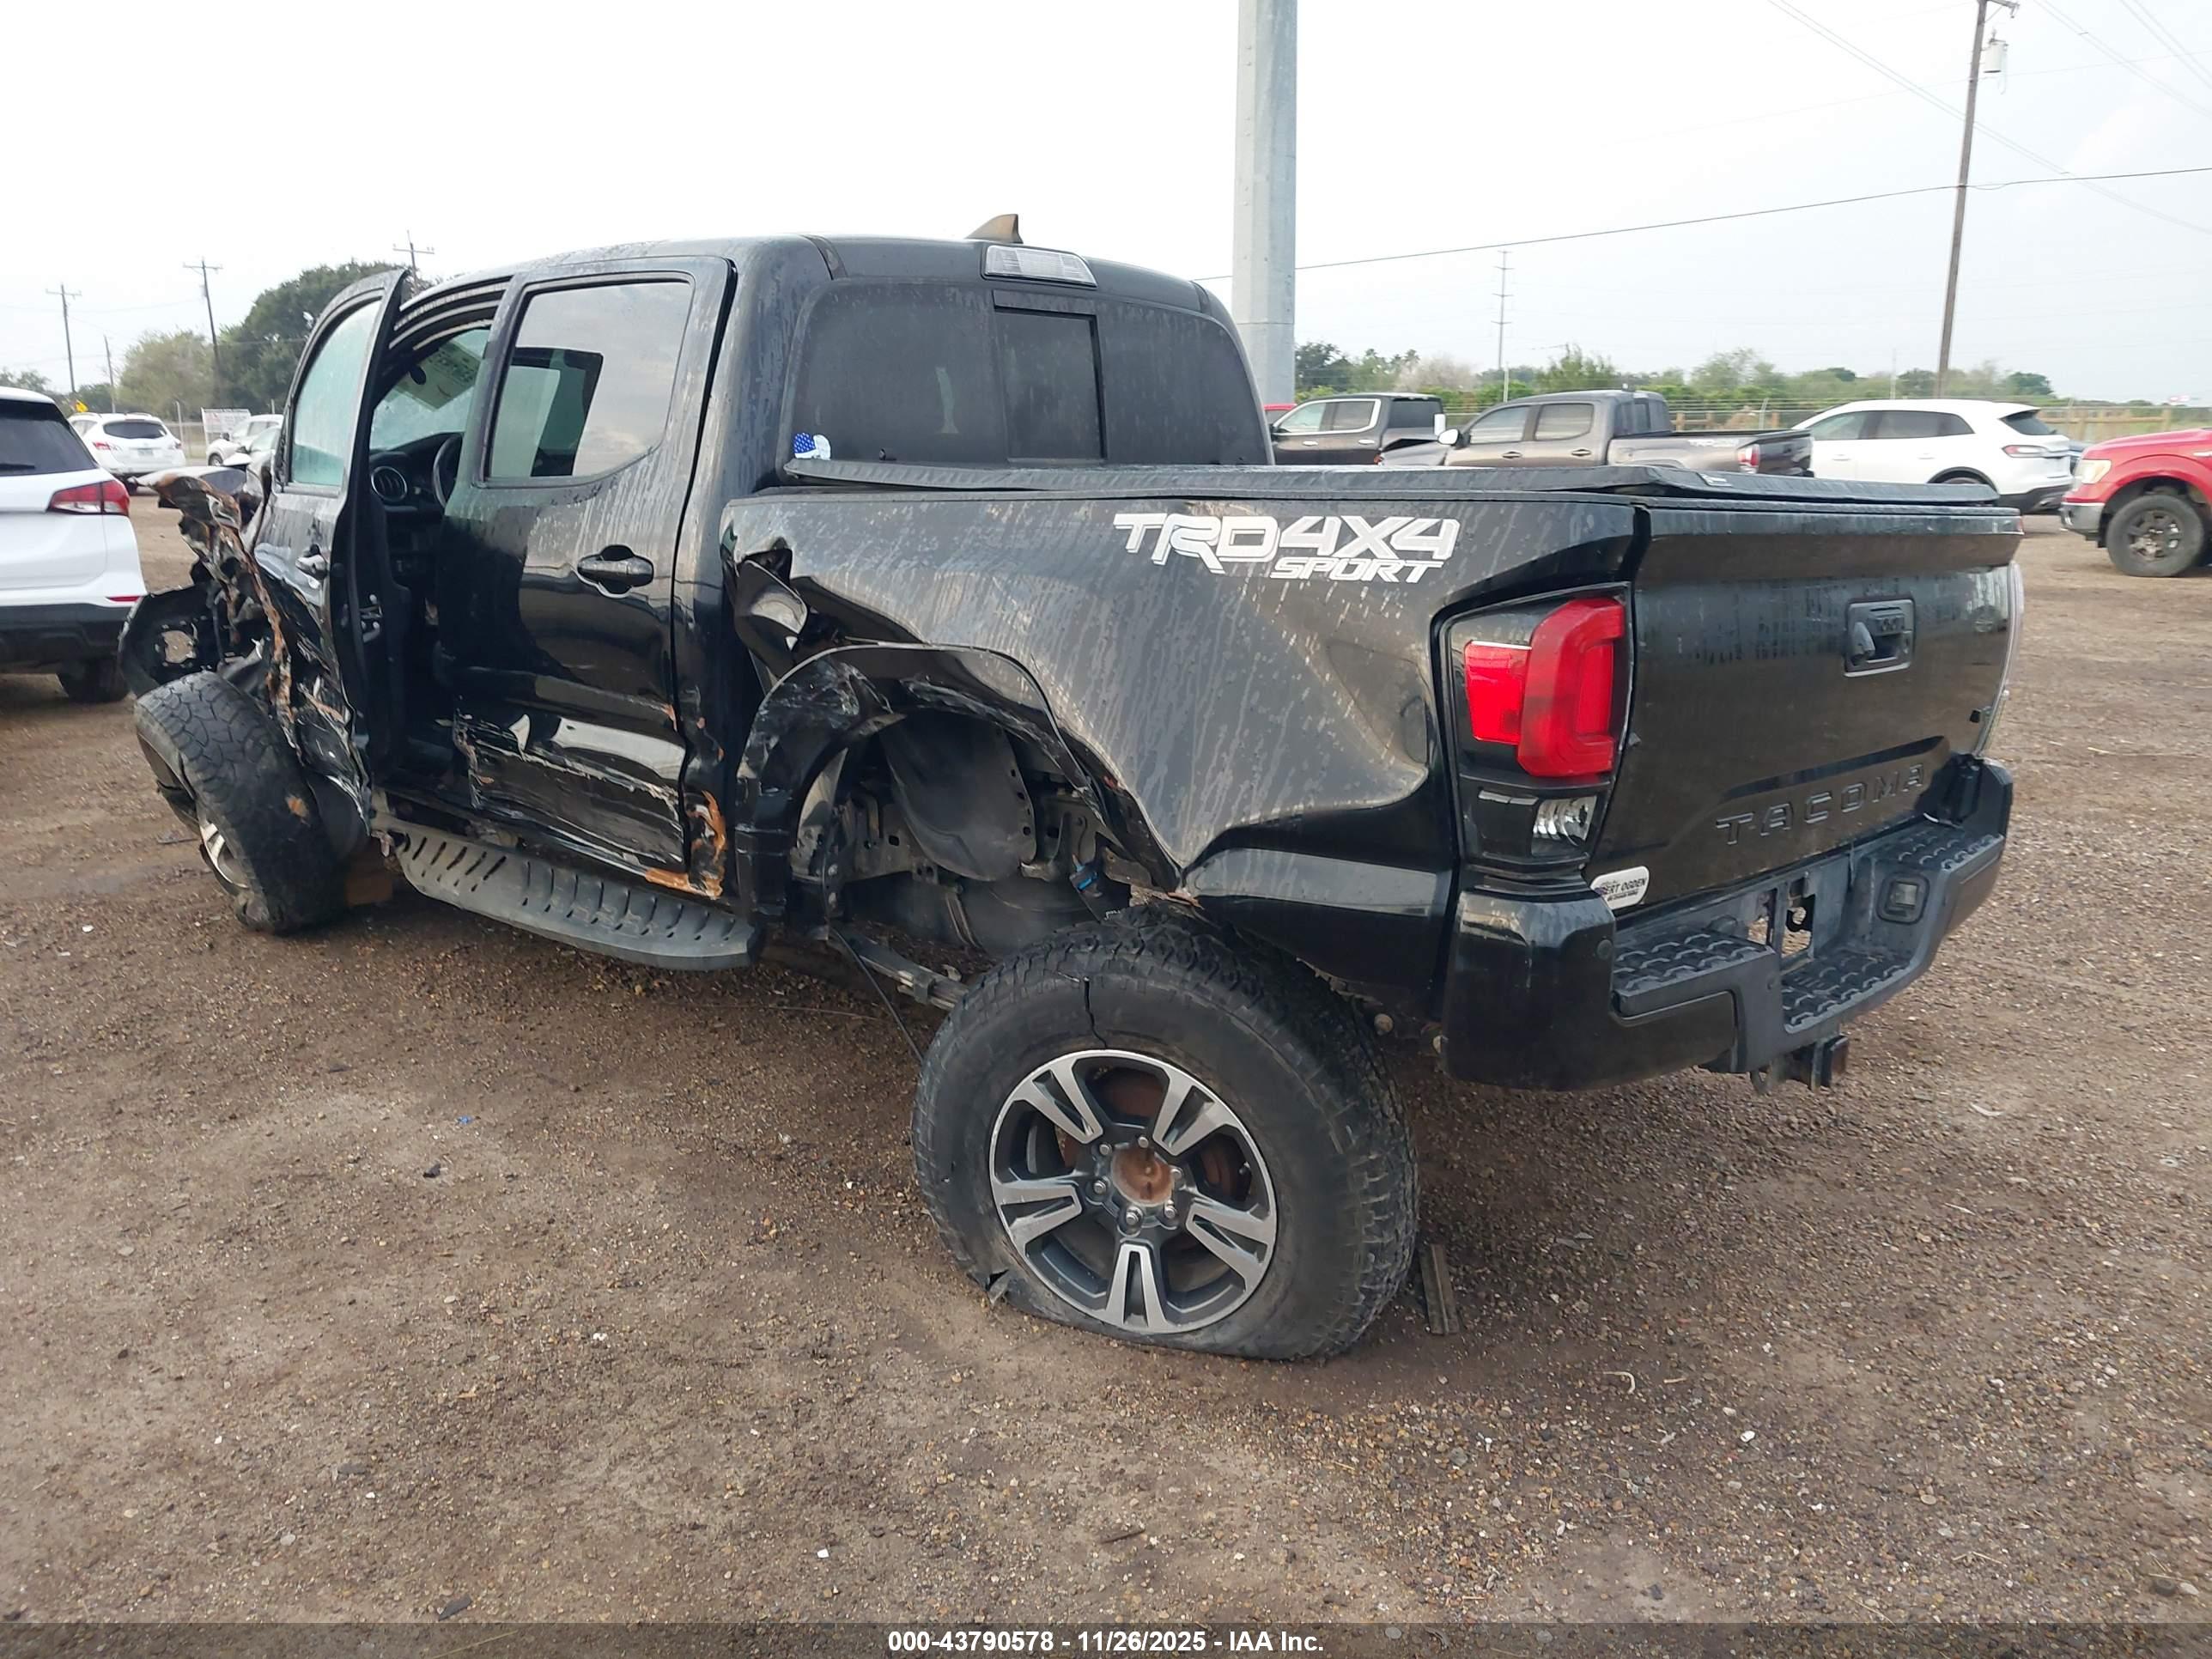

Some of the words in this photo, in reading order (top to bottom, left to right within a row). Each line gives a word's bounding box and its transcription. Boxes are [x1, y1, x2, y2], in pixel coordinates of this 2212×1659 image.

[1113, 513, 1280, 574] TRD
[1278, 515, 1461, 560] 4X4
[1270, 556, 1444, 583] SPORT
[1715, 763, 1924, 845] TACOMA
